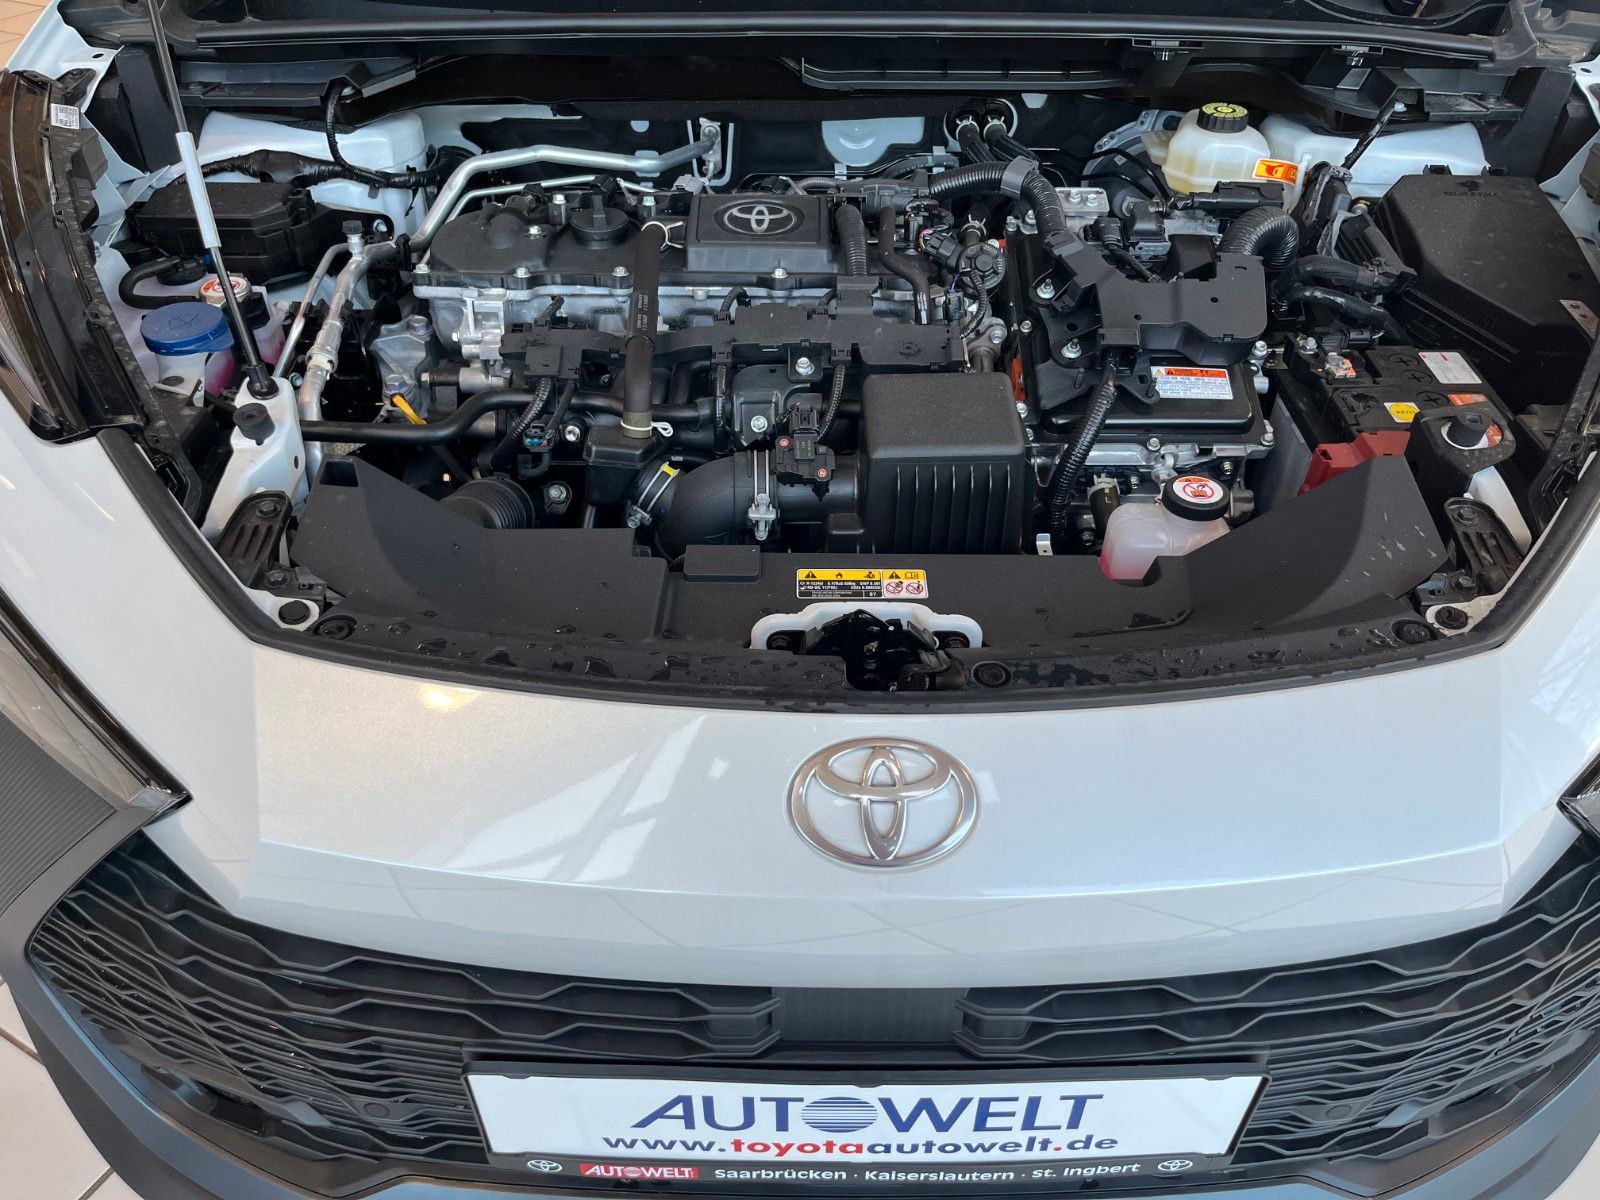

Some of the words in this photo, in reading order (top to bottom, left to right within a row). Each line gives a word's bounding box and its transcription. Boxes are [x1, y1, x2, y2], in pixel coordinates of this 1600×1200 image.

[630, 1094, 1104, 1133] AUTOWELT
[601, 1134, 1119, 1158] www.toyotaautowelt.de
[714, 1167, 846, 1181] Saarbrücken
[864, 1169, 1015, 1182] Kaiserslautern
[1031, 1167, 1057, 1179] St.
[1062, 1162, 1140, 1178] Ingbert
